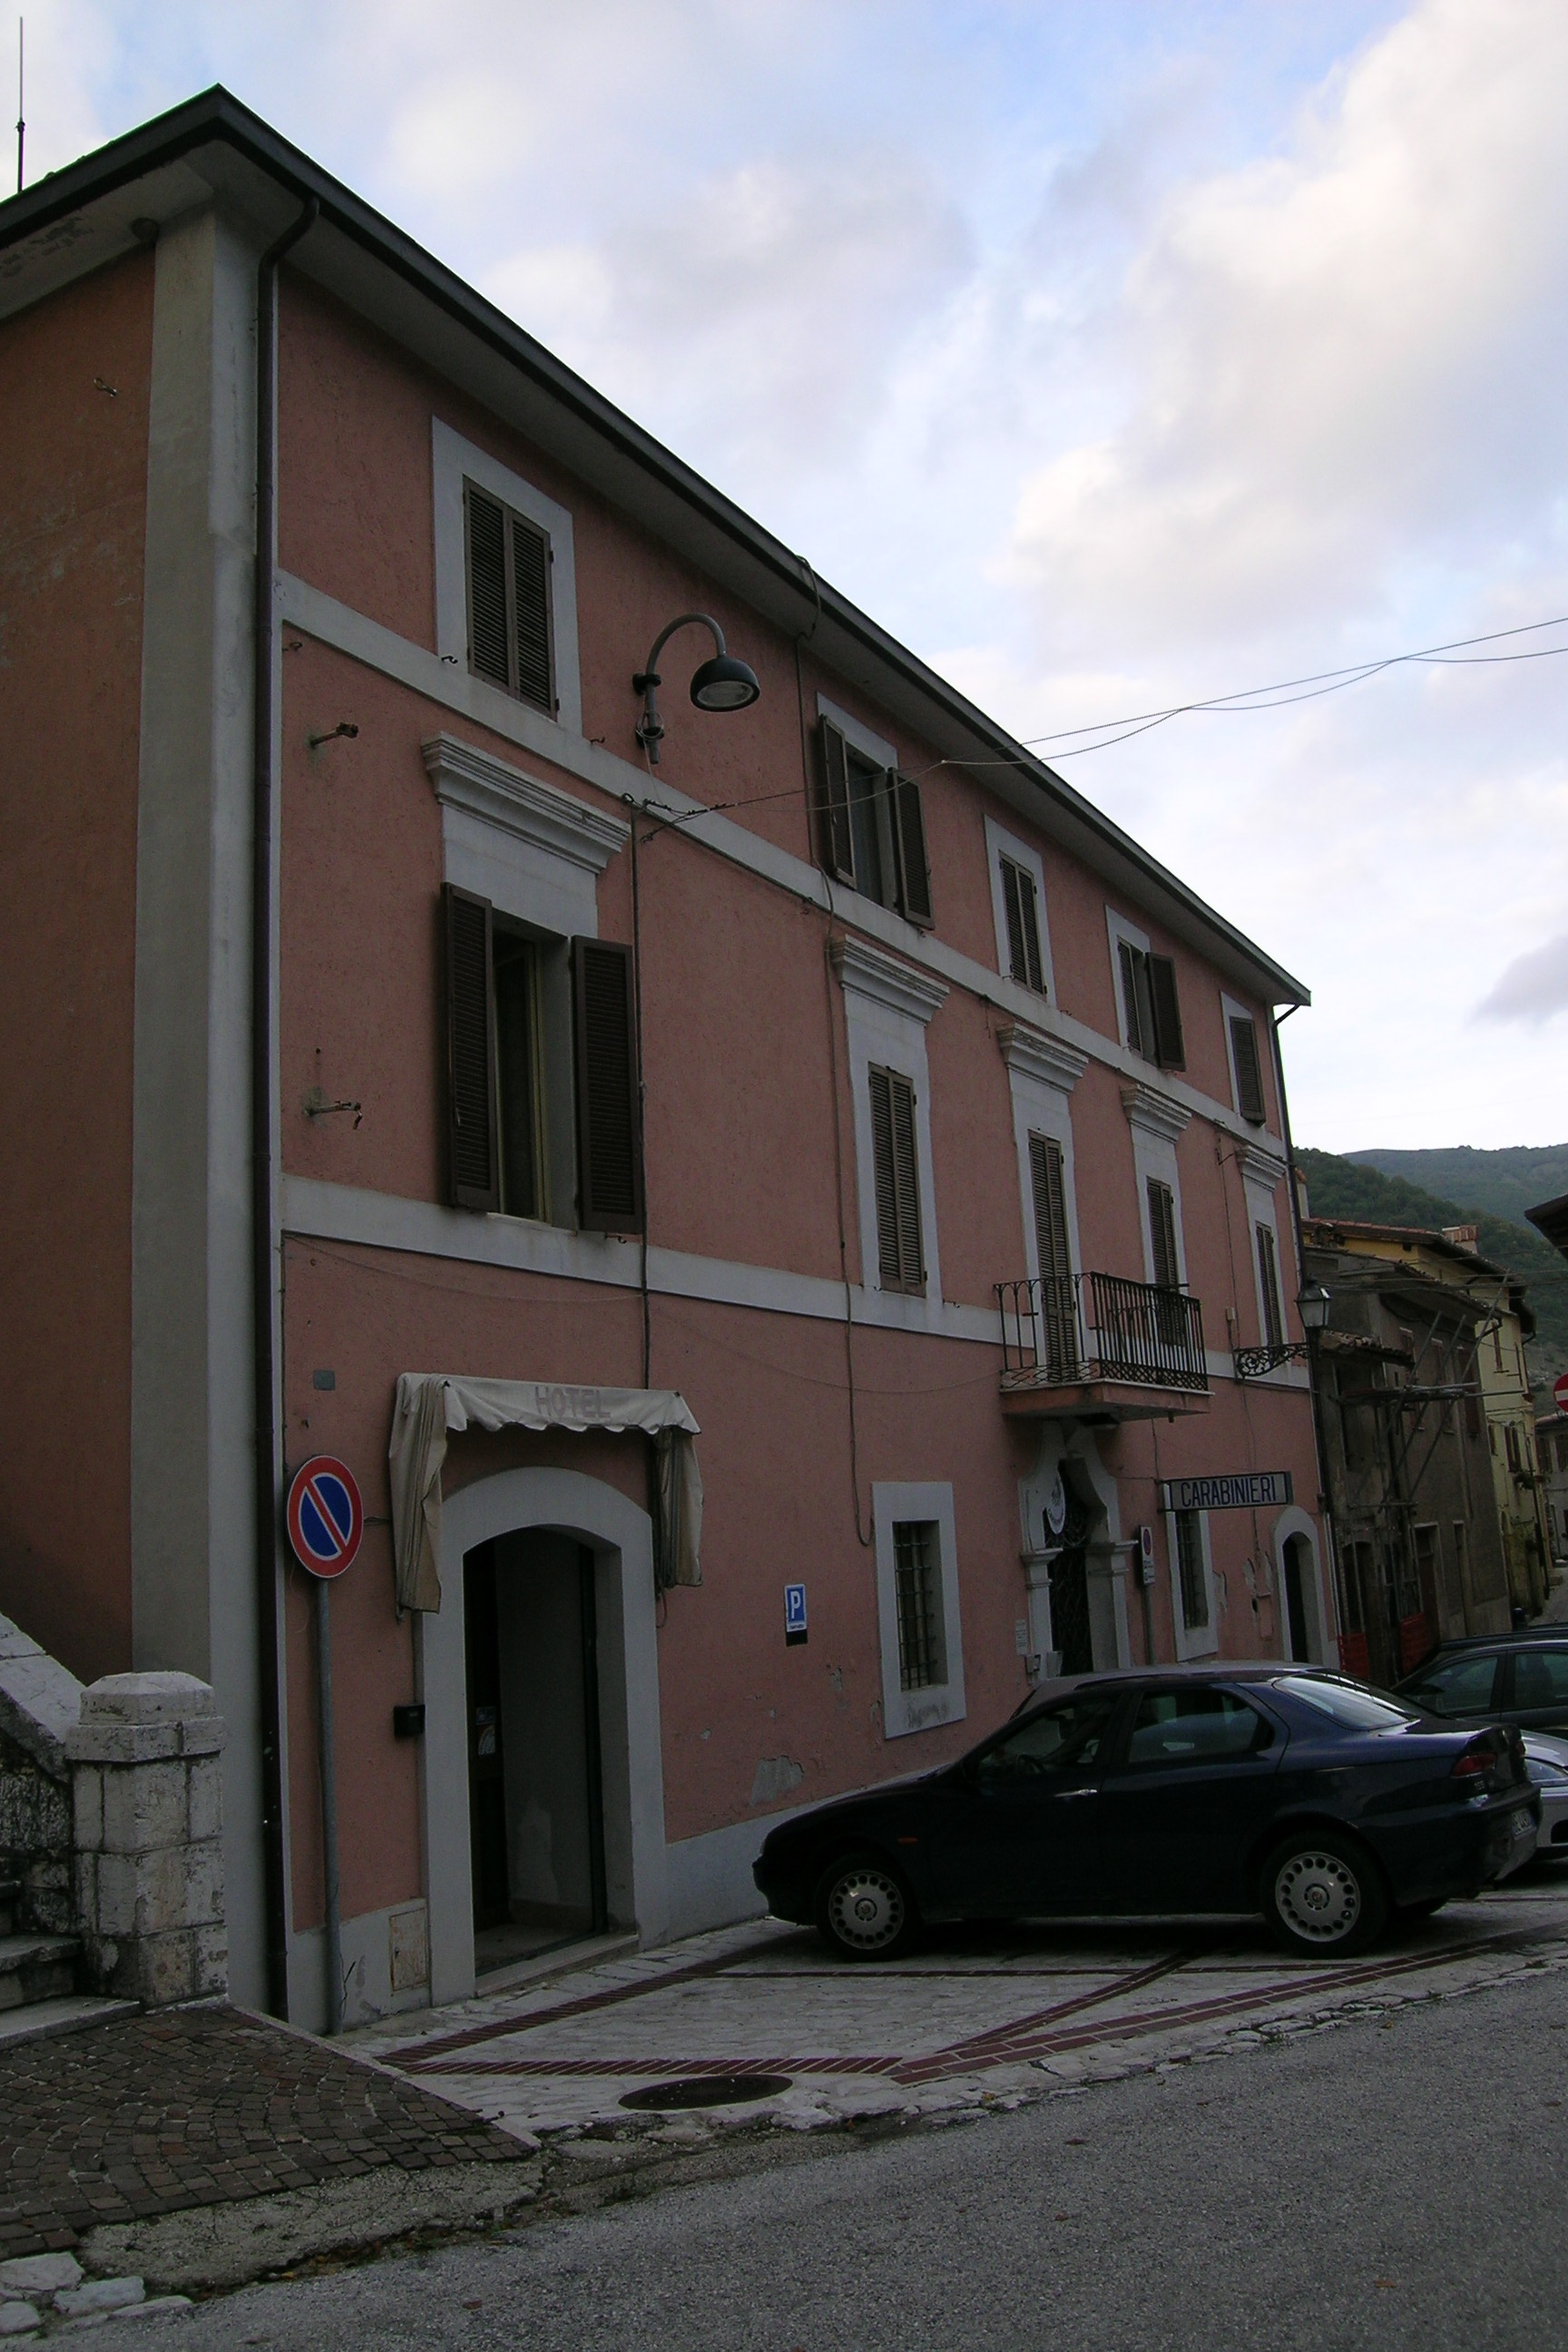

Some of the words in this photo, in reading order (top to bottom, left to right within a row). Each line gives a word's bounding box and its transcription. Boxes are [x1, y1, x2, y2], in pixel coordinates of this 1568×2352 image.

[534, 1386, 611, 1419] HOTEL
[1181, 1475, 1277, 1508] CARABINIERI
[790, 1590, 801, 1620] P
